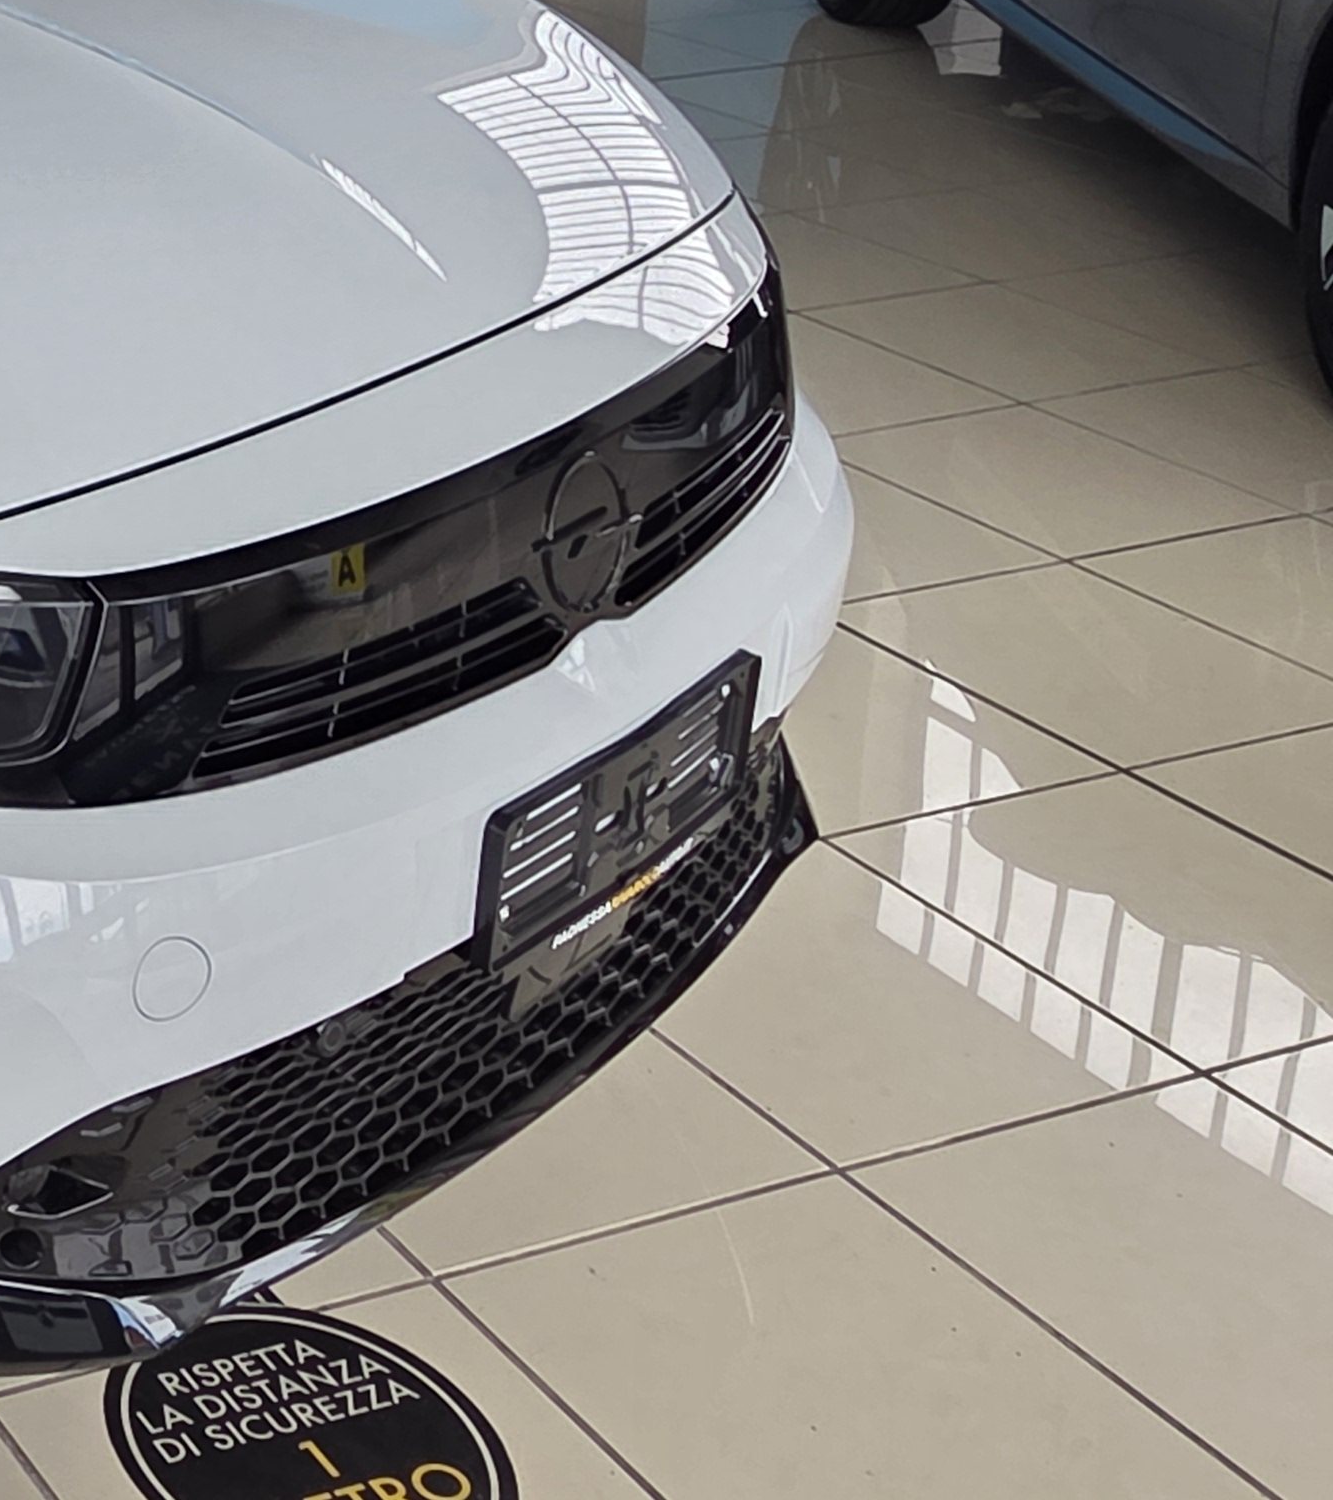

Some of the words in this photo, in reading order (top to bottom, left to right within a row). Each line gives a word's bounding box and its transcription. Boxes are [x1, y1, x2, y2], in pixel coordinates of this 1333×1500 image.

[136, 1404, 194, 1435] LA
[193, 1355, 392, 1421] DISTANZA
[157, 1339, 328, 1398] RISPETTA
[152, 1433, 202, 1464] DI
[205, 1379, 421, 1452] SICUREZZA
[298, 1440, 341, 1478] 1
